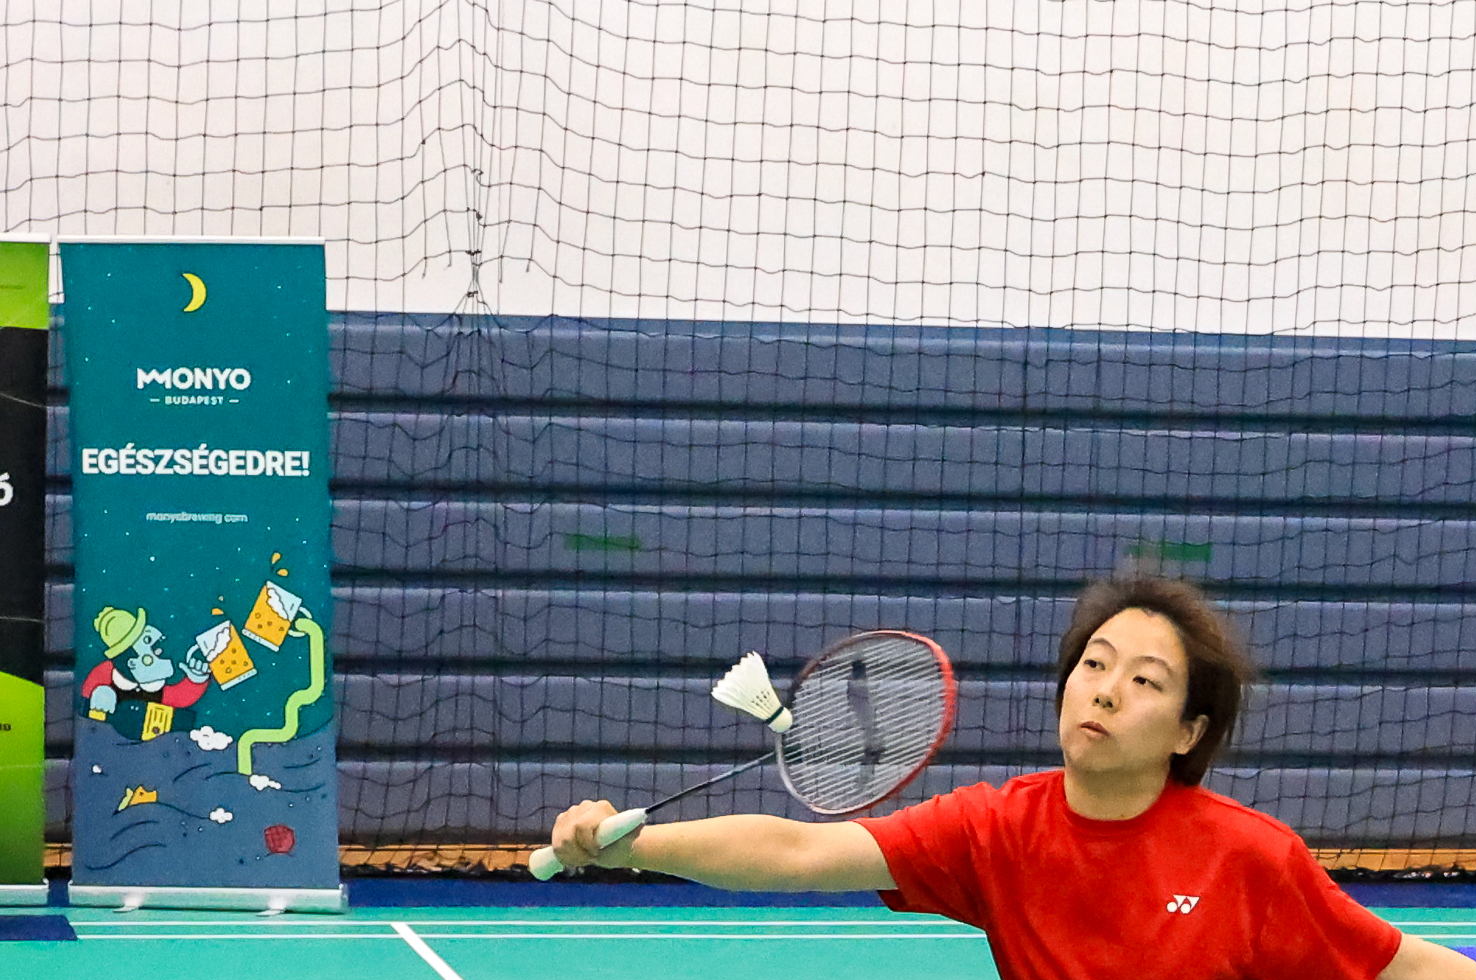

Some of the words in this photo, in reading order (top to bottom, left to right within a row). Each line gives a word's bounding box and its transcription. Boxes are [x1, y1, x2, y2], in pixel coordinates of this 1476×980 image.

[137, 367, 251, 390] MONYO
[164, 395, 224, 406] BUDAPEST
[82, 443, 310, 476] EGÉSZSÉGEDRE!
